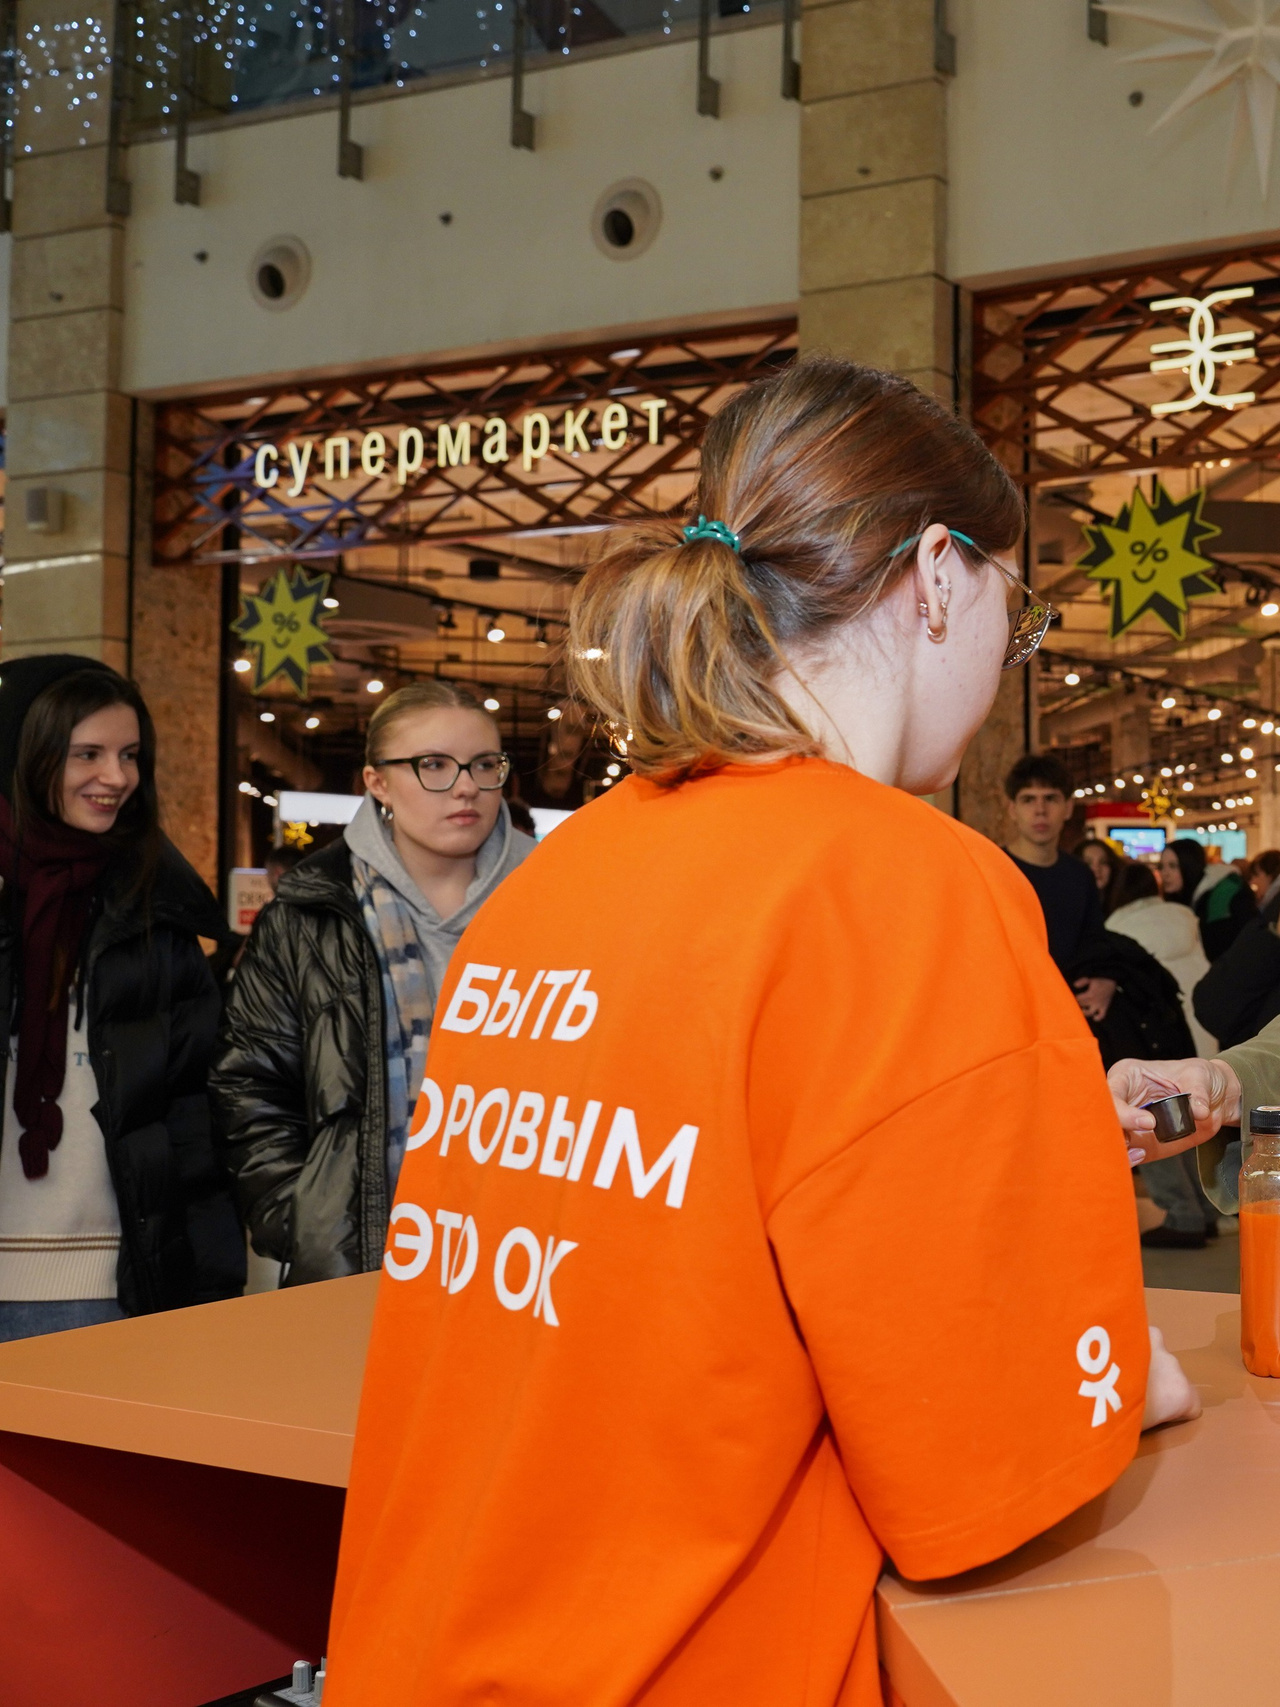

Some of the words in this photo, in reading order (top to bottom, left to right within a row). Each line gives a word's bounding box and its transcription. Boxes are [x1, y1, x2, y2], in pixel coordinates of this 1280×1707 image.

[254, 397, 669, 498] супермаркет
[440, 962, 599, 1042] БЫТЬ
[405, 1077, 700, 1209] ОРОВЫМ
[384, 1202, 479, 1295] ЭТО
[493, 1226, 580, 1327] ОК
